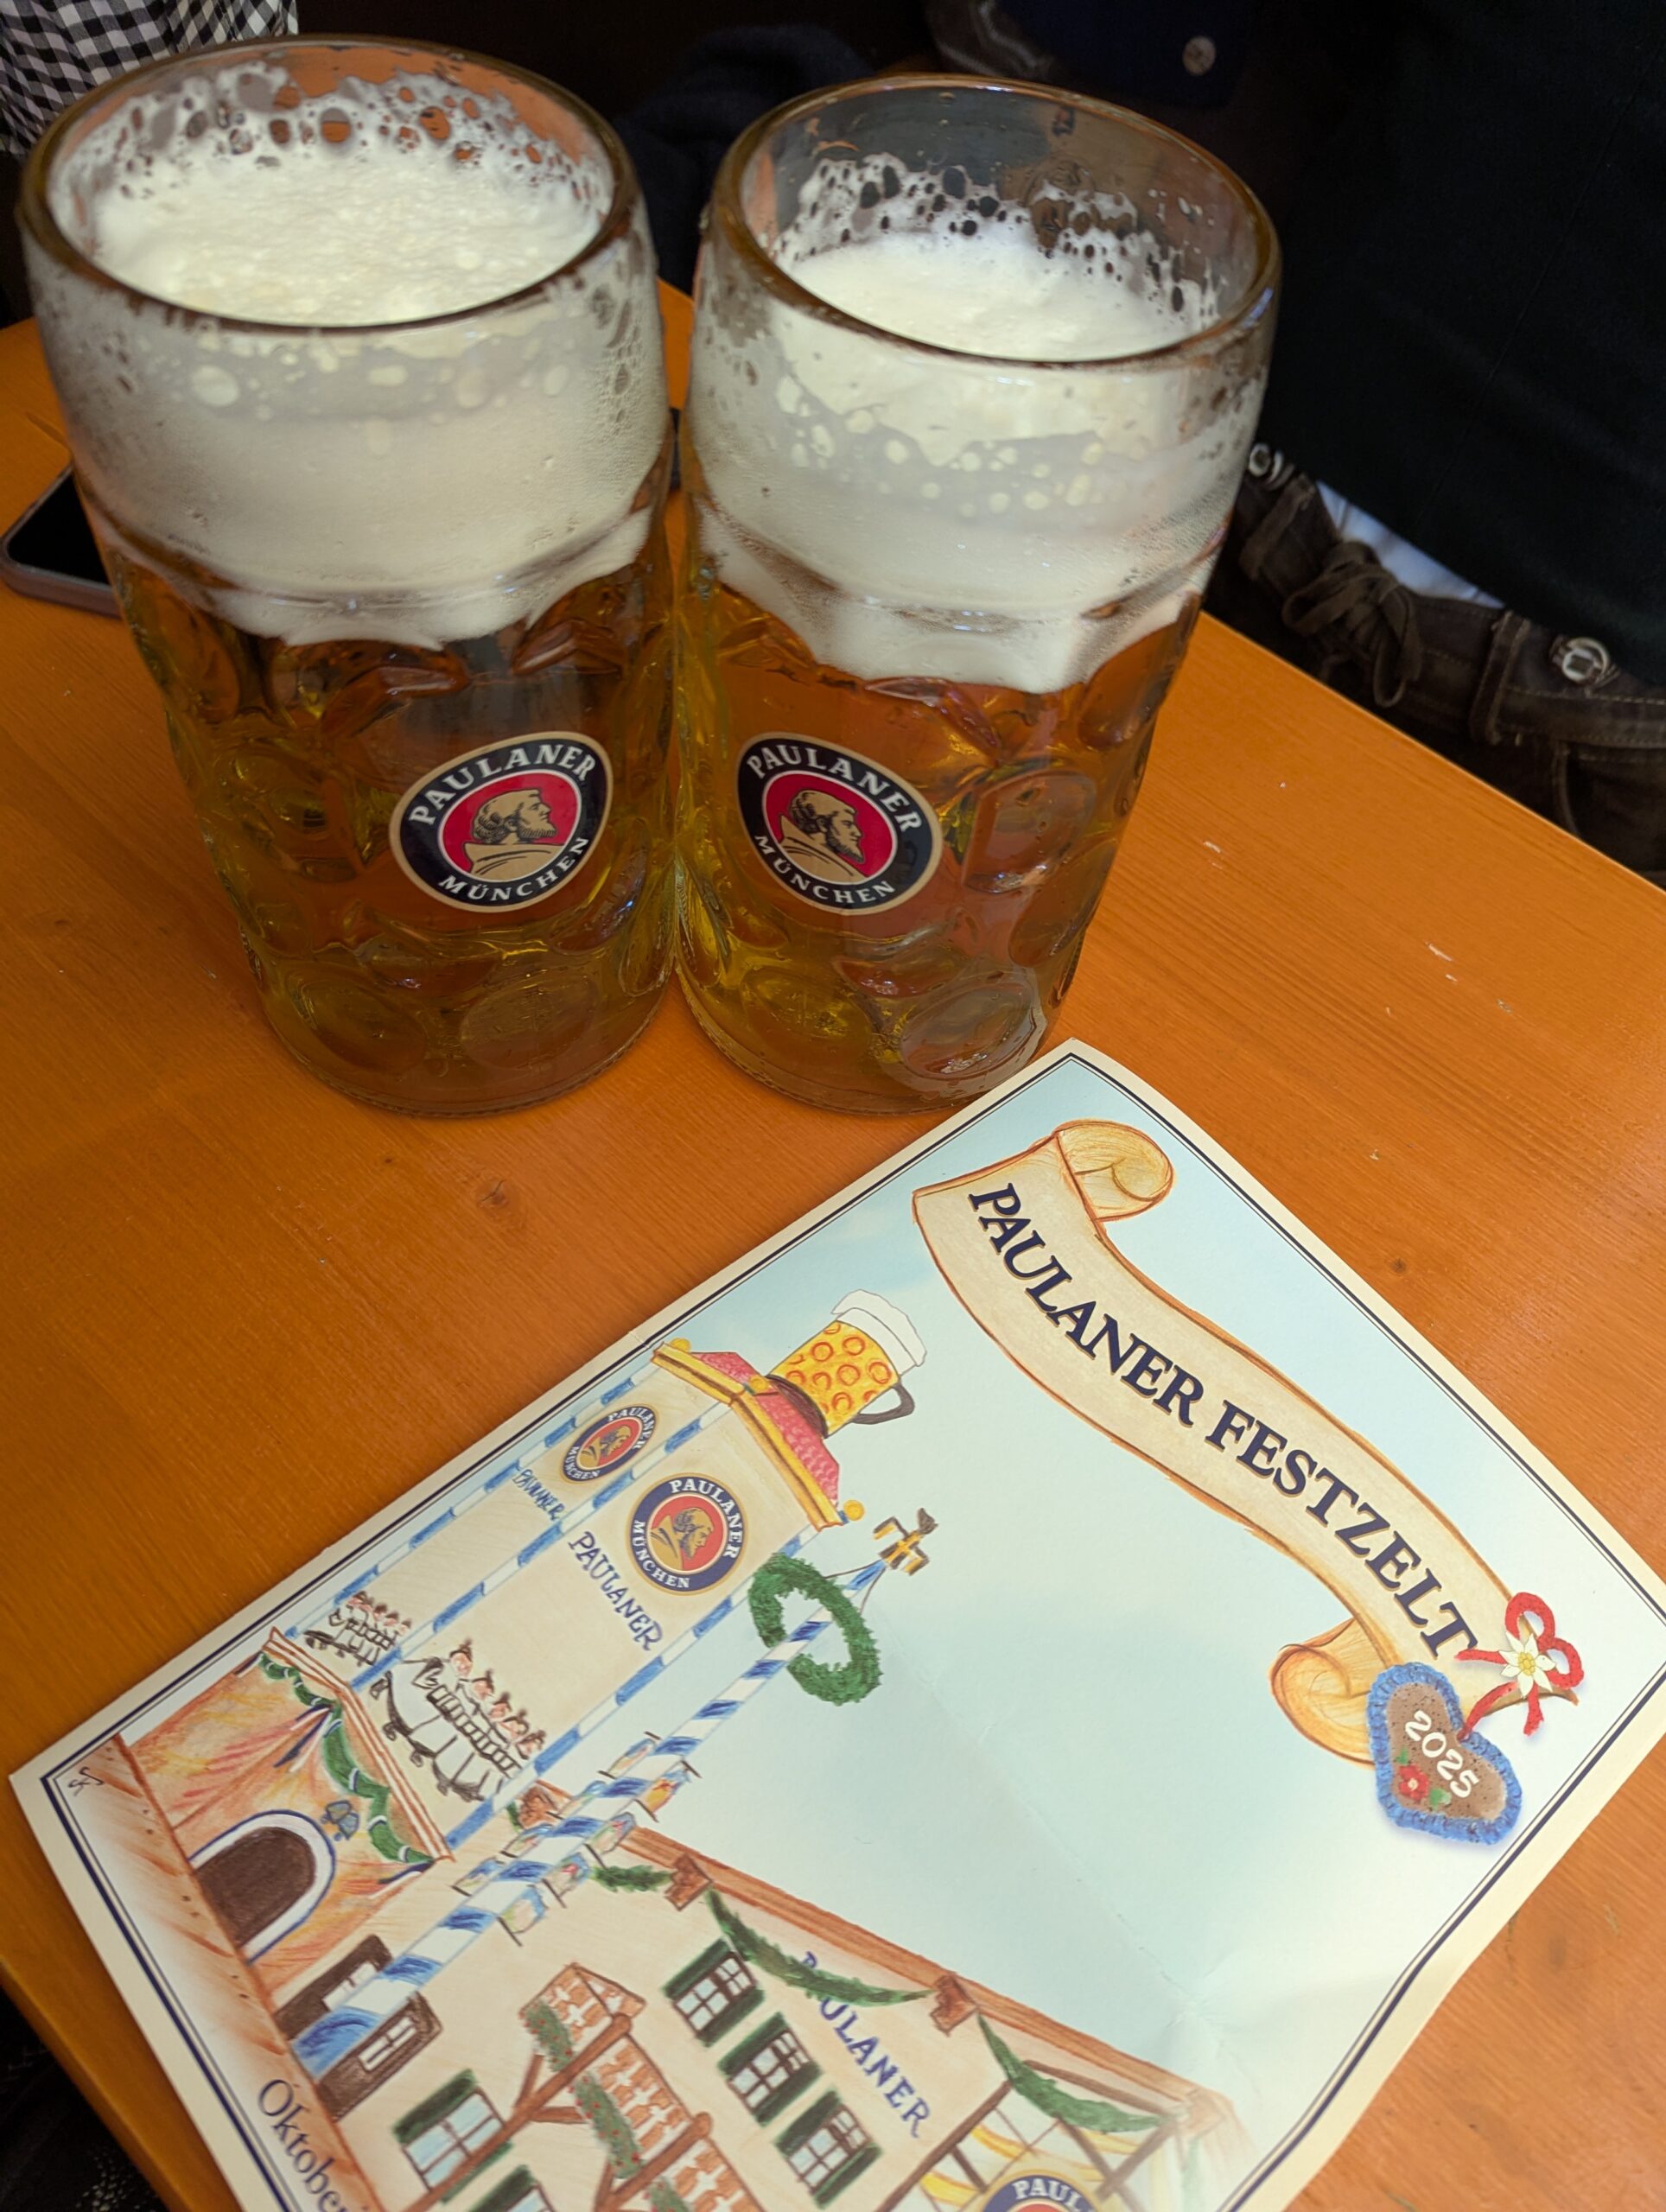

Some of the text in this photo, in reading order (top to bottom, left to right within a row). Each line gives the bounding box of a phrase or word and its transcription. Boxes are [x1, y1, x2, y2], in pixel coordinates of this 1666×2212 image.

[409, 743, 596, 826] PAULANER
[746, 744, 923, 831] PAULANER
[437, 836, 589, 902] MÜNCHEN
[754, 834, 896, 905] MÜNCHEN
[968, 1181, 1478, 1658] PAULANER FESTZELT
[633, 1519, 690, 1589] MÜNCHEN
[668, 1478, 744, 1559] PAULANER
[568, 1530, 664, 1651] PAULANER
[1403, 1710, 1481, 1801] 2025
[801, 1950, 931, 2139] PULANER
[258, 2079, 349, 2212] Oktobe
[1012, 2177, 1096, 2212] PAUL
